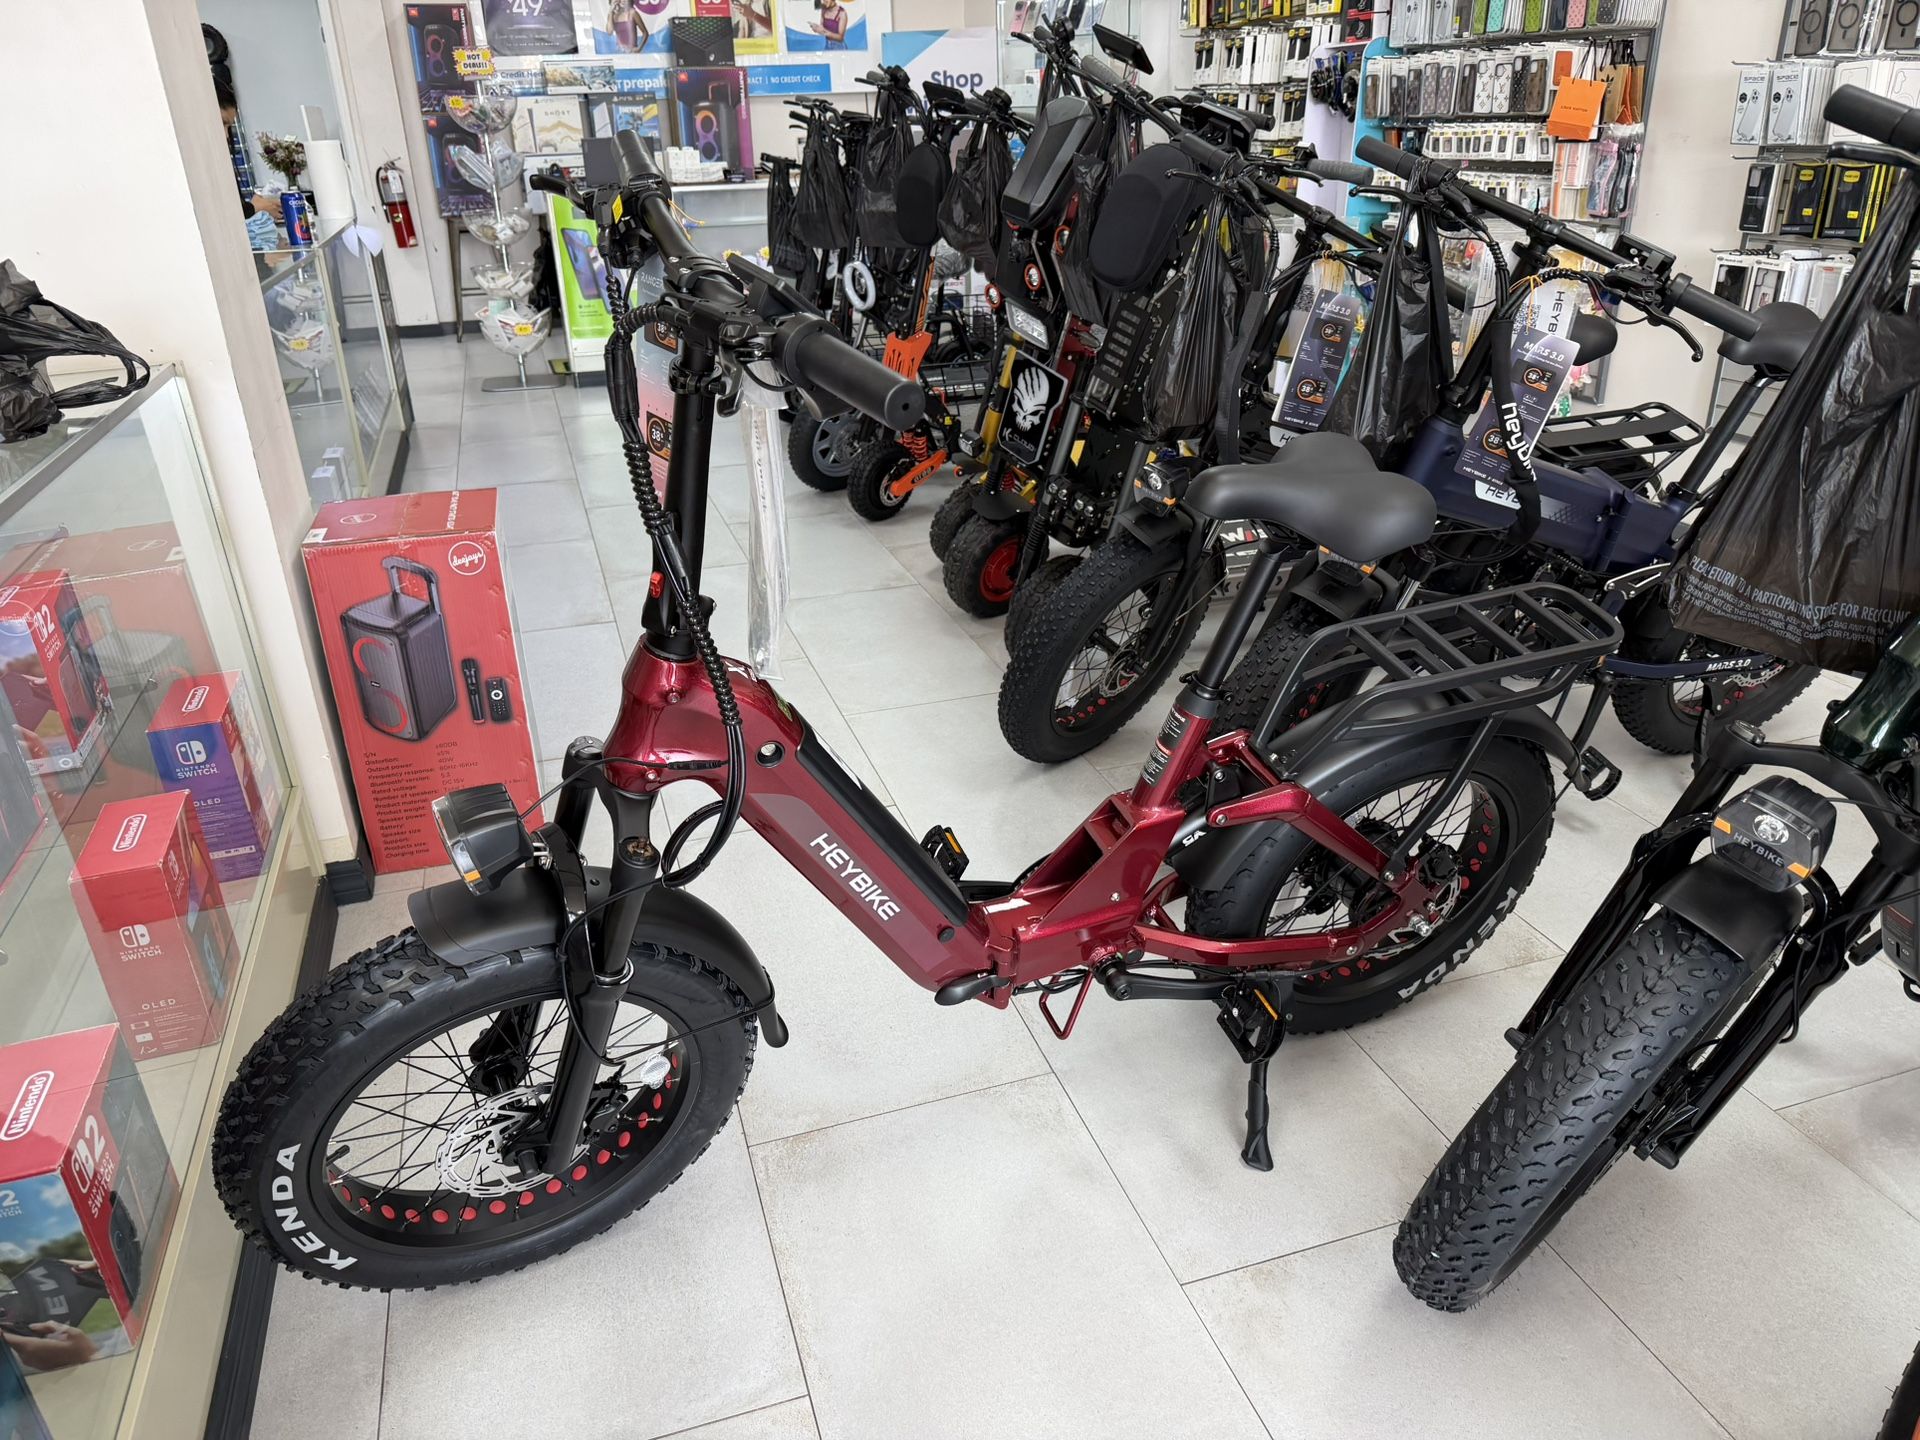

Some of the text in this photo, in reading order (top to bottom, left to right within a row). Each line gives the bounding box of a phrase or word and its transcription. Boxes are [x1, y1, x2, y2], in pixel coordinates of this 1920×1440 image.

[500, 71, 525, 79] Credit
[780, 76, 801, 84] CREDIT
[802, 75, 821, 83] CHECK
[1339, 306, 1351, 316] 3.0
[1547, 291, 1566, 335] HEYB
[1523, 341, 1550, 356] MARS
[1549, 351, 1565, 361] 3.0
[1488, 435, 1499, 444] 38
[453, 552, 483, 567] deejays
[1711, 596, 1723, 607] NOT
[1722, 602, 1734, 612] USE
[1839, 603, 1859, 619] FOR
[42, 604, 55, 634] 2
[176, 763, 216, 773] NINTENDO
[177, 767, 218, 779] SWITCH
[193, 797, 221, 807] OLED
[1733, 831, 1784, 867] HEYBIKE
[809, 833, 900, 921] HEYBIKE
[1397, 886, 1518, 999] KENDA
[121, 949, 162, 962] SWITCH
[141, 998, 176, 1011] OLED
[8, 1075, 47, 1136] Nintendo
[84, 1114, 106, 1163] 2
[91, 1159, 115, 1219] SWITCH
[272, 1143, 358, 1271] KENDA
